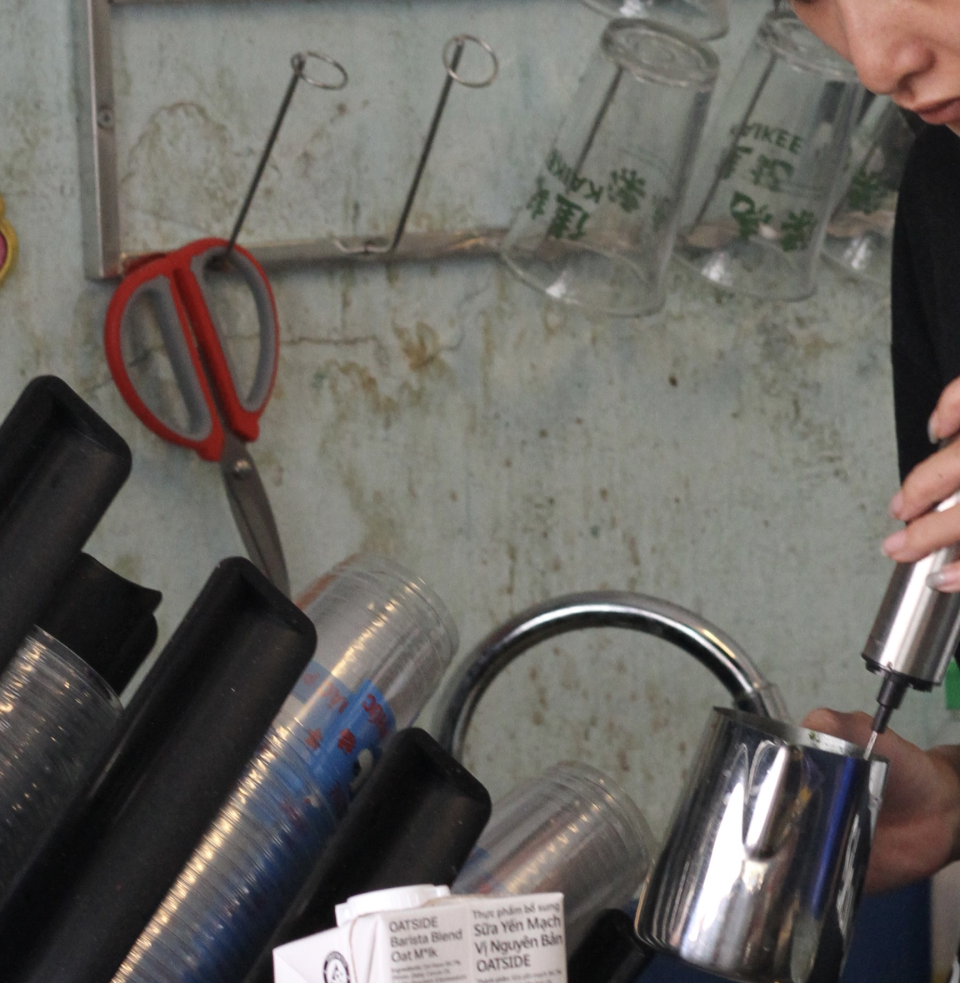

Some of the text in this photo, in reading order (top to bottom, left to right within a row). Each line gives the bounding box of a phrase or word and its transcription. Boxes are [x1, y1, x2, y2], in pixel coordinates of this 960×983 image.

[389, 916, 438, 932] OATSIDE
[474, 921, 499, 938] Sữa
[527, 915, 562, 932] Mạch
[390, 929, 463, 948] Barista Blend
[475, 932, 563, 956] Vị Nguyên Bản
[391, 950, 412, 964] Oat
[476, 954, 532, 973] OATSIDE
